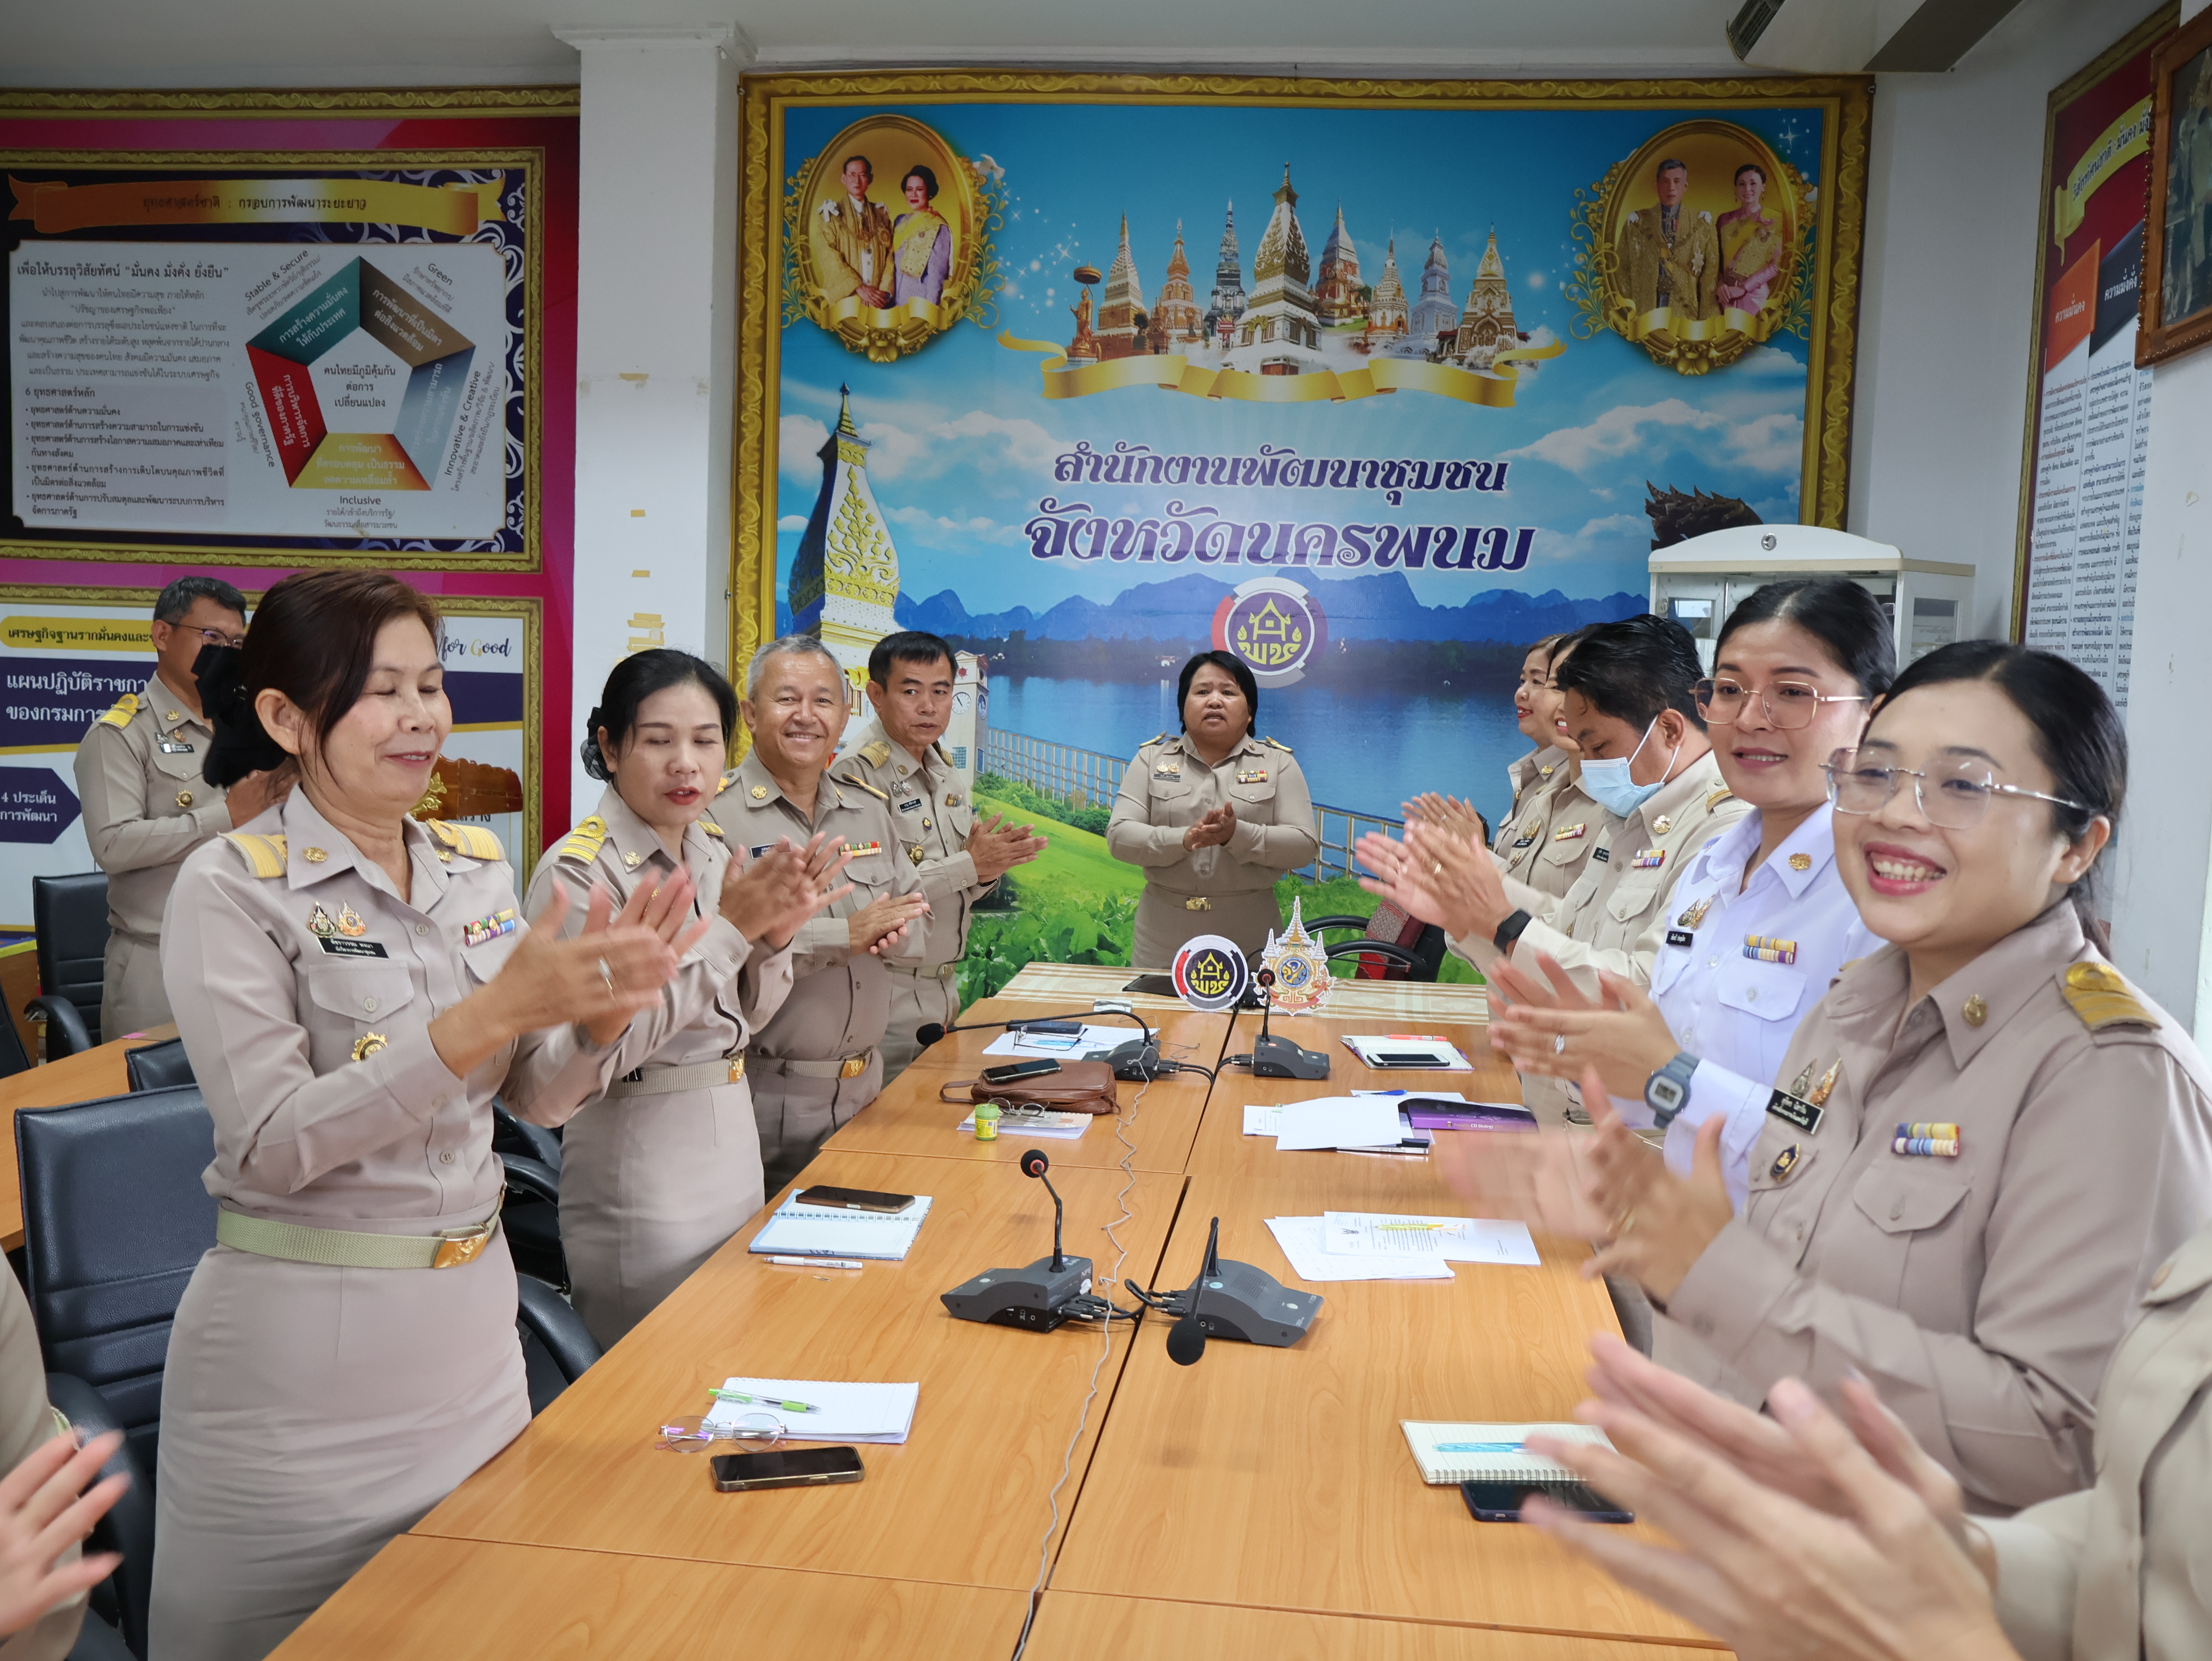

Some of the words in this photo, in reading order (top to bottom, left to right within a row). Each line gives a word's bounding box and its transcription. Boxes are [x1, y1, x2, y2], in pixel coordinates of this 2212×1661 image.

[238, 193, 367, 211] กรอบการพัฒนาระยะยาว
[17, 260, 120, 280] เพื่อให้บรรลุวิสัยทัศน์
[164, 261, 191, 277] มั่งคั่ง
[244, 278, 272, 301] Stable
[272, 271, 281, 280] &
[279, 250, 309, 274] Secure
[428, 263, 453, 286] Green
[2104, 265, 2137, 301] ความมั่งคั่ง
[279, 287, 348, 344] การสร้างความมั่นคง
[2055, 293, 2085, 323] ความมั่นคง
[296, 307, 346, 347] ให้กับประเทศ
[324, 364, 396, 380] คนไทยมีภูมิคุ้มกัน
[24, 388, 31, 396] 6
[34, 386, 95, 399] ยุทธศาสตร์หลัก
[346, 382, 374, 392] ต่อการ
[462, 370, 481, 411] Creative
[283, 374, 311, 448] การบริหารจัดการ
[335, 396, 386, 408] เปลี่ยนแปลง
[245, 381, 259, 409] Good
[252, 410, 275, 468] governance
[460, 412, 469, 423] &
[444, 424, 466, 476] Innovative
[1053, 440, 1511, 507] สำนักงานพัฒนาชุมชน
[340, 495, 382, 506] Inclusive
[1024, 497, 1537, 571] จังหวัดนครพนม
[470, 637, 512, 657] Good
[1, 792, 9, 803] 4
[13, 790, 56, 805] ประเด็น
[0, 808, 57, 823] การพัฒนา
